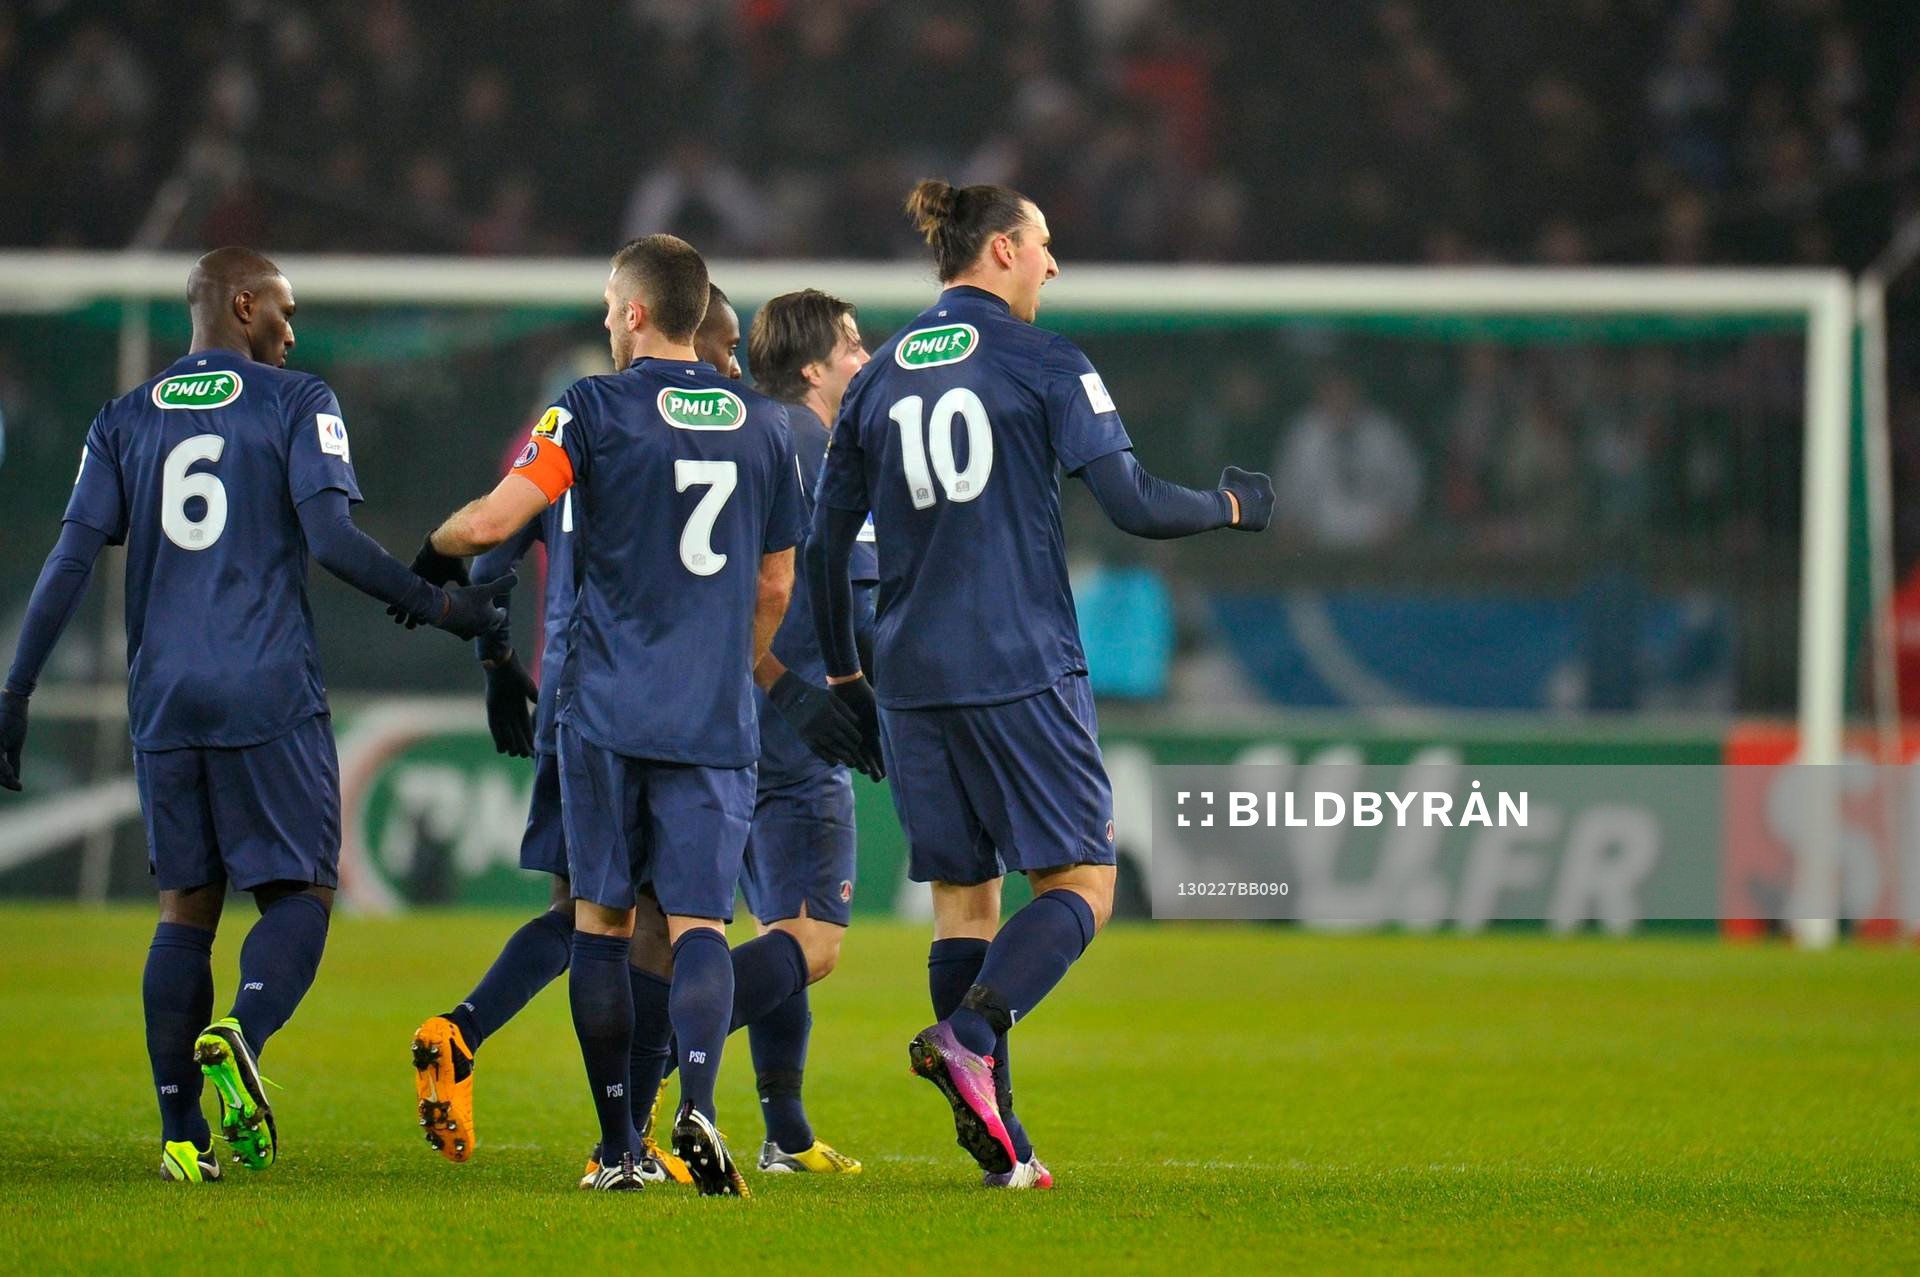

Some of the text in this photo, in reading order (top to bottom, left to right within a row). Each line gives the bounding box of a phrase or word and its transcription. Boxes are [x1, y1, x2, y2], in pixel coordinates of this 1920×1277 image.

[905, 335, 950, 358] PMU
[164, 380, 212, 398] PMU
[669, 396, 714, 416] PMU
[889, 387, 994, 511] 10
[161, 433, 228, 551] 6
[674, 459, 738, 576] 7
[380, 764, 545, 880] PM
[689, 1050, 706, 1065] PSG
[161, 1084, 179, 1095] PSG
[606, 1083, 624, 1098] PSG
